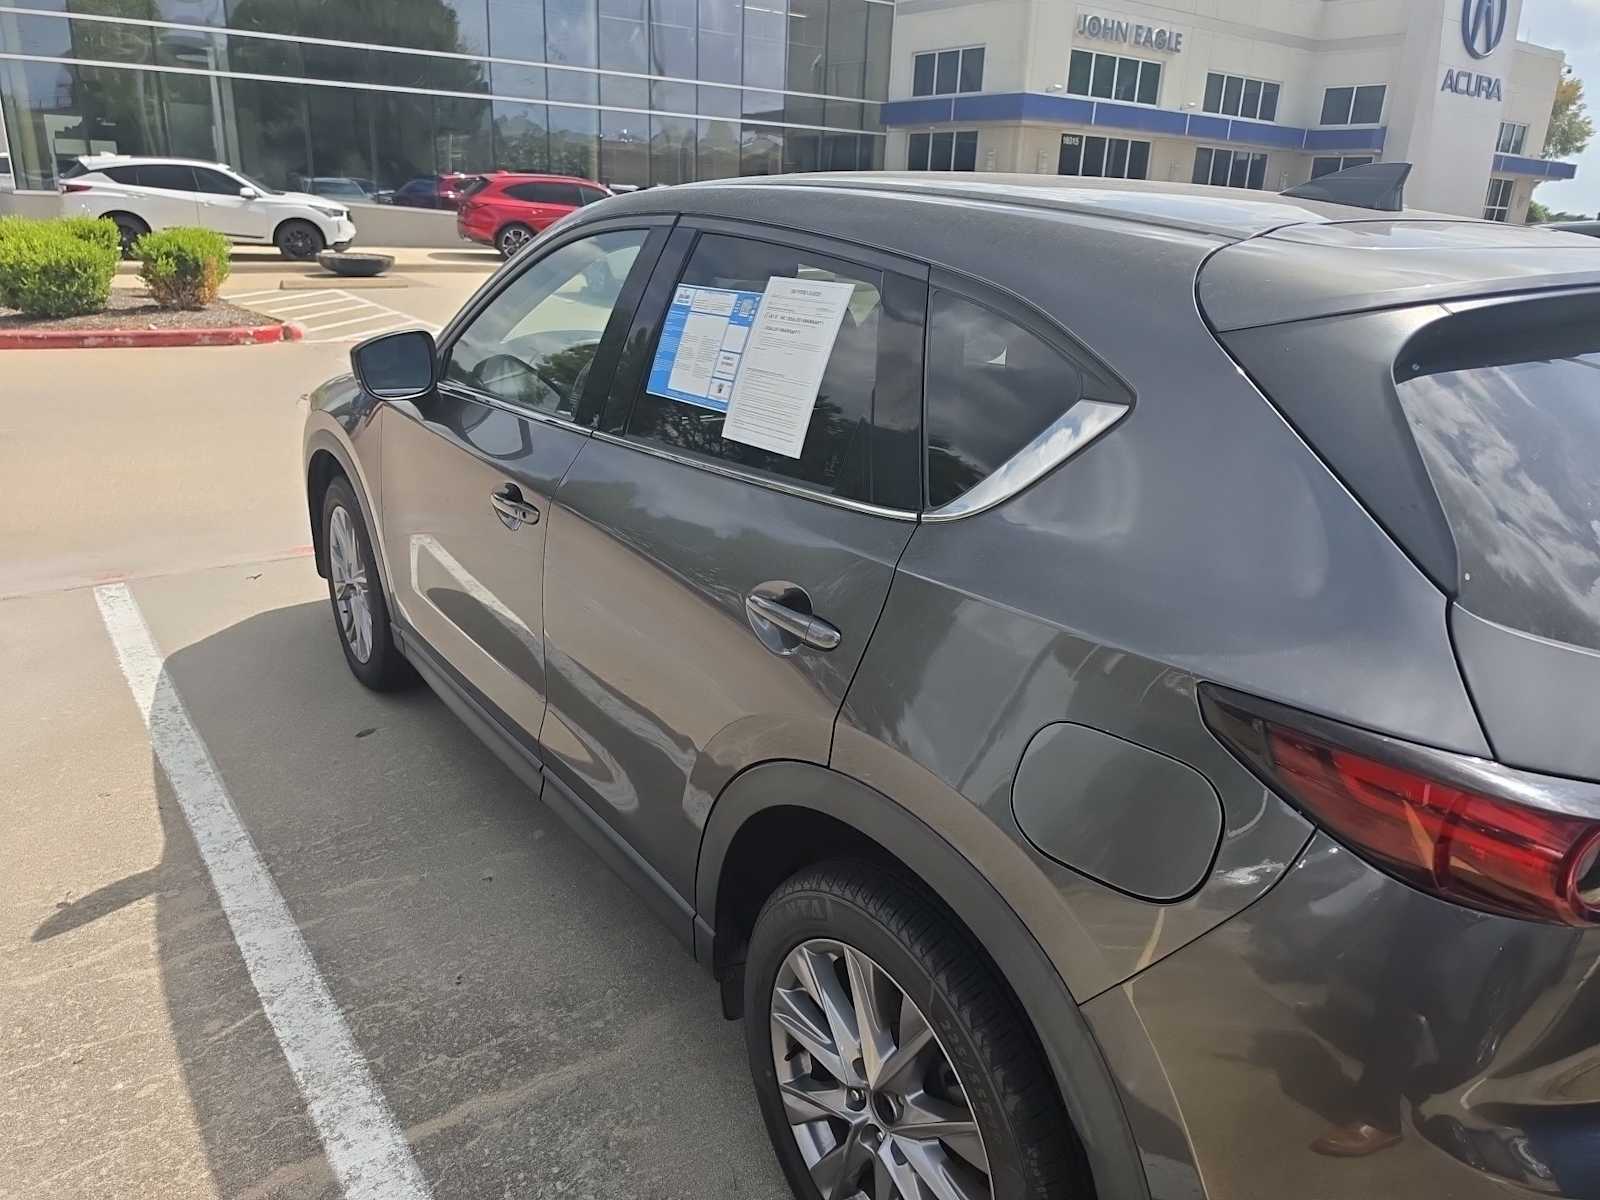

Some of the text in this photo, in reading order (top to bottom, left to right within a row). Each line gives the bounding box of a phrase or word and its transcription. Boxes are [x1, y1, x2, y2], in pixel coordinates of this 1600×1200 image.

[1078, 14, 1183, 53] JOHN EAGLE
[1440, 68, 1502, 102] ACURA
